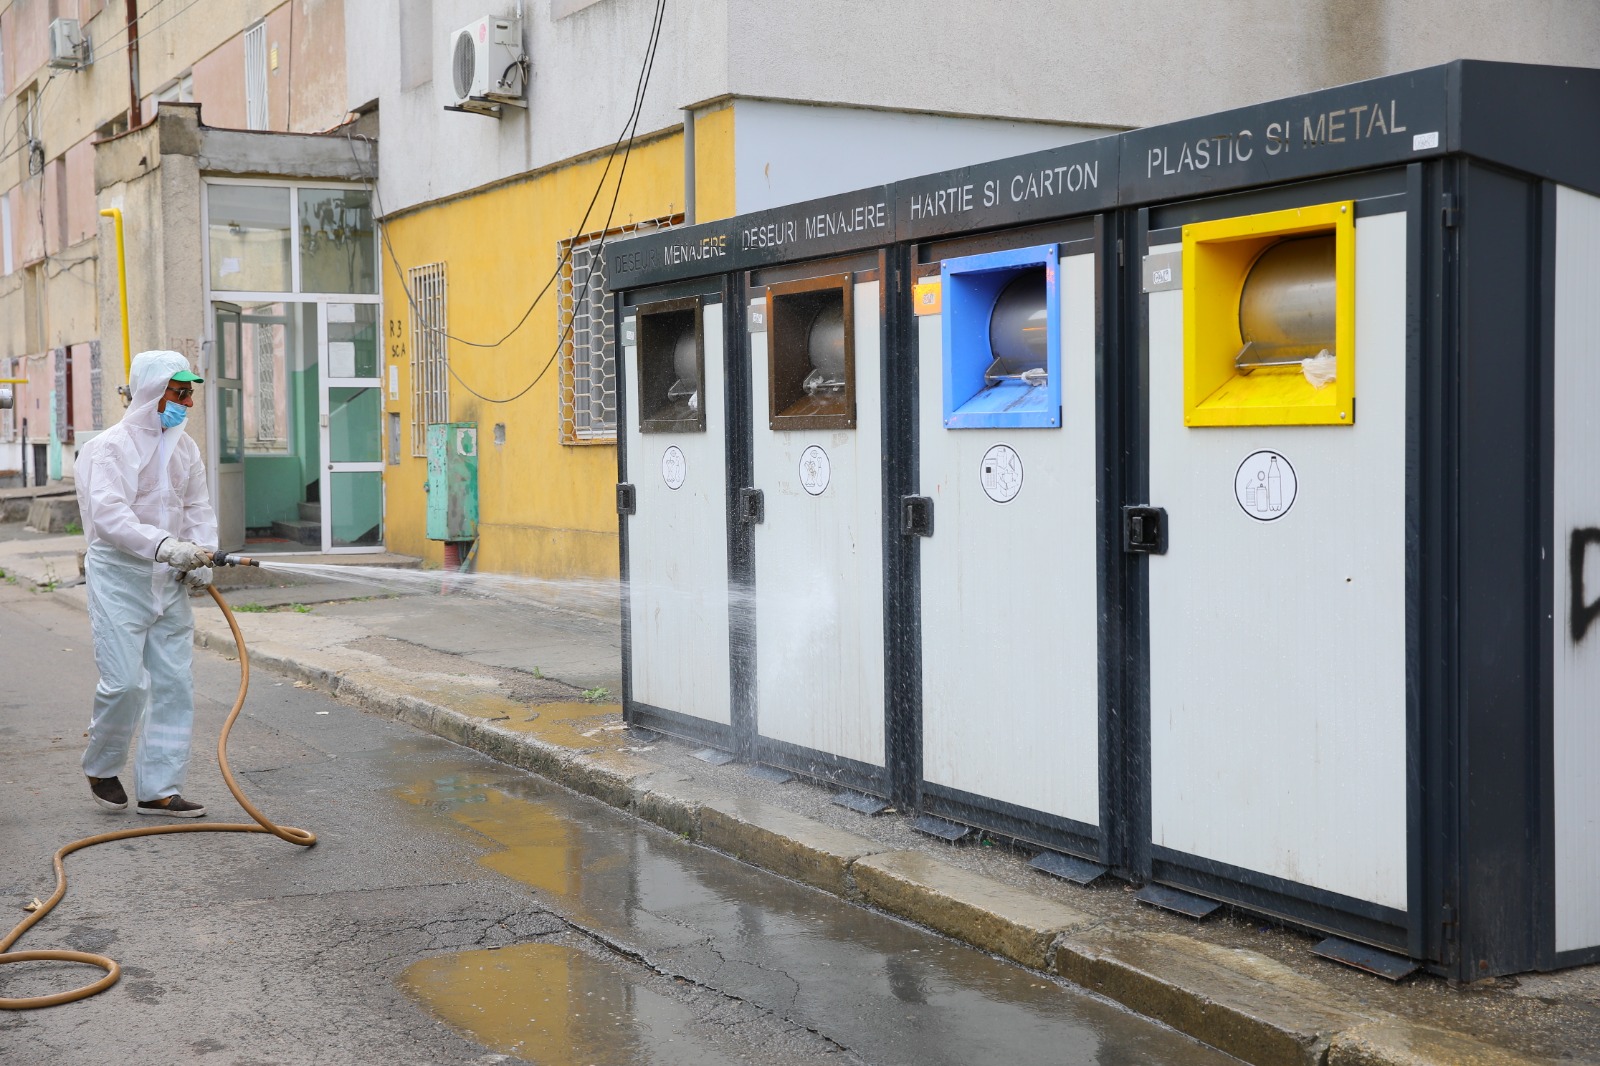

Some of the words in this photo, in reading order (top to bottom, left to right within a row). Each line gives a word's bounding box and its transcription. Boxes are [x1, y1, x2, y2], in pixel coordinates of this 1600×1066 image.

[1147, 129, 1253, 178] PLASTIC
[1265, 120, 1290, 156] SI
[1303, 100, 1407, 149] METAL
[911, 184, 974, 220] HARTIE
[983, 179, 1000, 207] SI
[1010, 160, 1099, 202] CARTON
[664, 235, 726, 266] MENAJERE
[742, 221, 797, 251] DESEURI
[805, 202, 885, 240] MENAJERE
